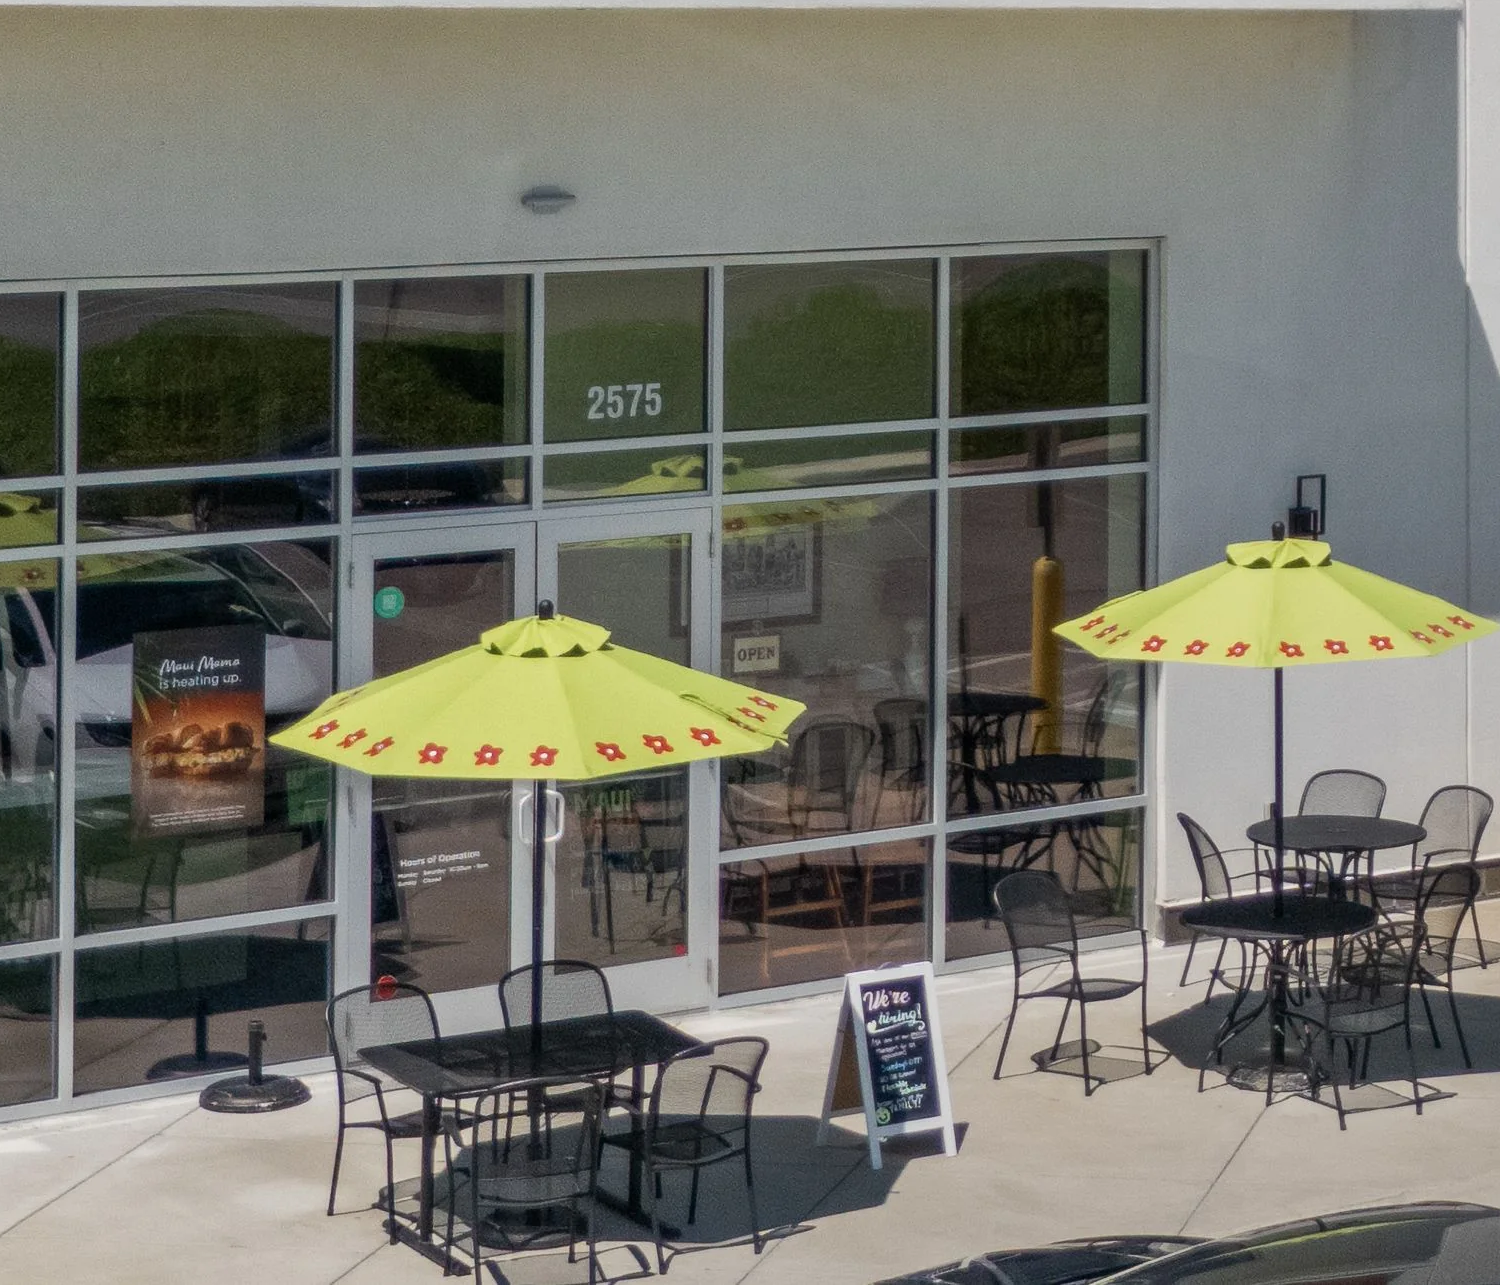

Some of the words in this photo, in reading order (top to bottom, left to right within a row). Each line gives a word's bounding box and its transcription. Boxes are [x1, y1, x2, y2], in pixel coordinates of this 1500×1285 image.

[587, 382, 662, 420] 2575
[737, 646, 775, 662] OPEN
[159, 658, 195, 675] Maui
[172, 675, 219, 688] heating
[222, 674, 242, 684] up.
[400, 857, 426, 867] Hours
[427, 855, 436, 864] of
[438, 850, 481, 862] Operation
[862, 989, 911, 1011] We're
[878, 1002, 922, 1027] hiring!
